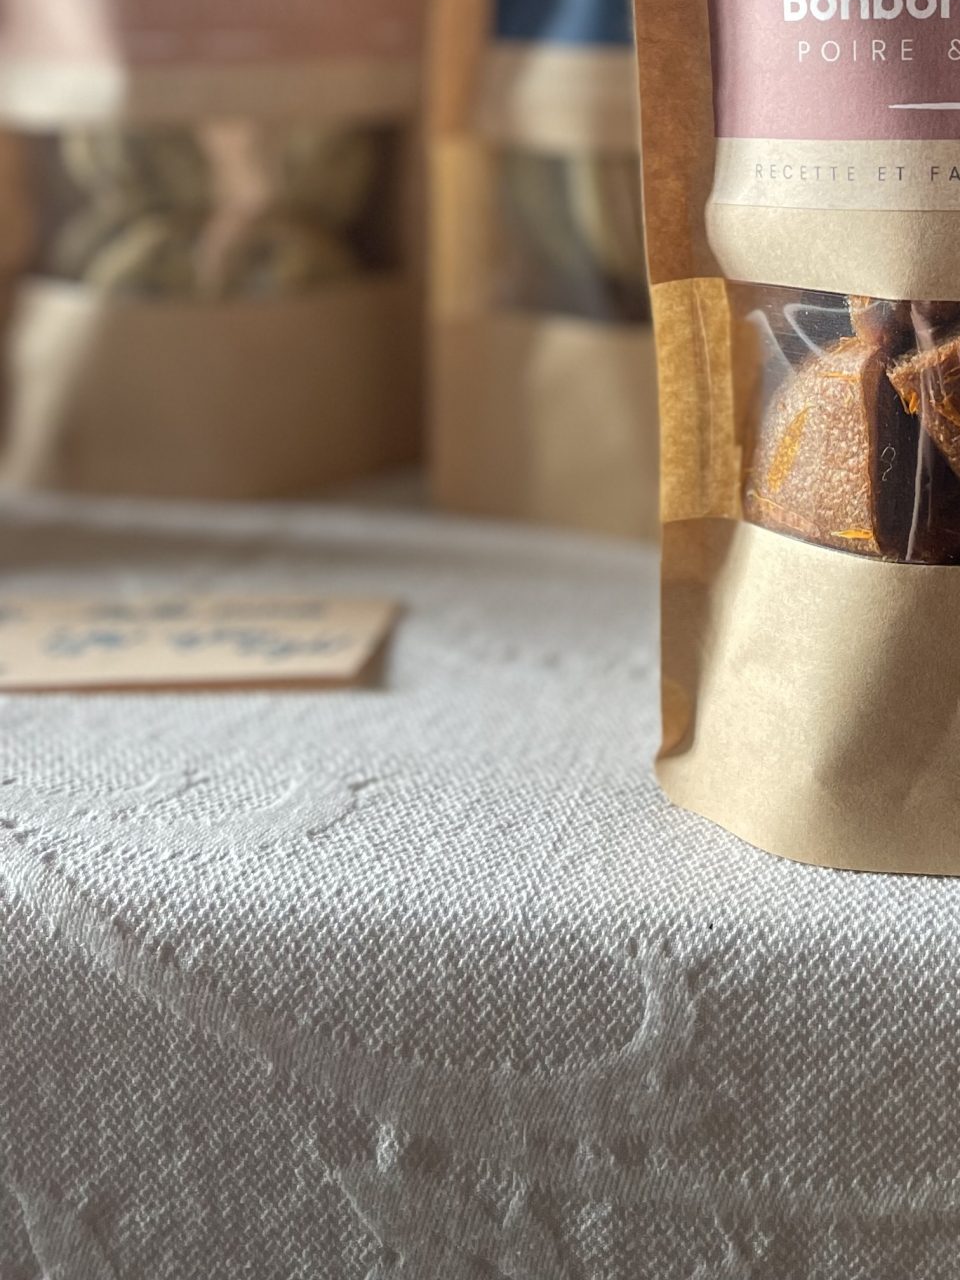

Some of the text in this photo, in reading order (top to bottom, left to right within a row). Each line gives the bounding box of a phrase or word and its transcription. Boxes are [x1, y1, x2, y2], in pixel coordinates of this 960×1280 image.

[798, 38, 914, 62] POIRE
[755, 163, 856, 182] RECETTE
[877, 166, 905, 182] ET
